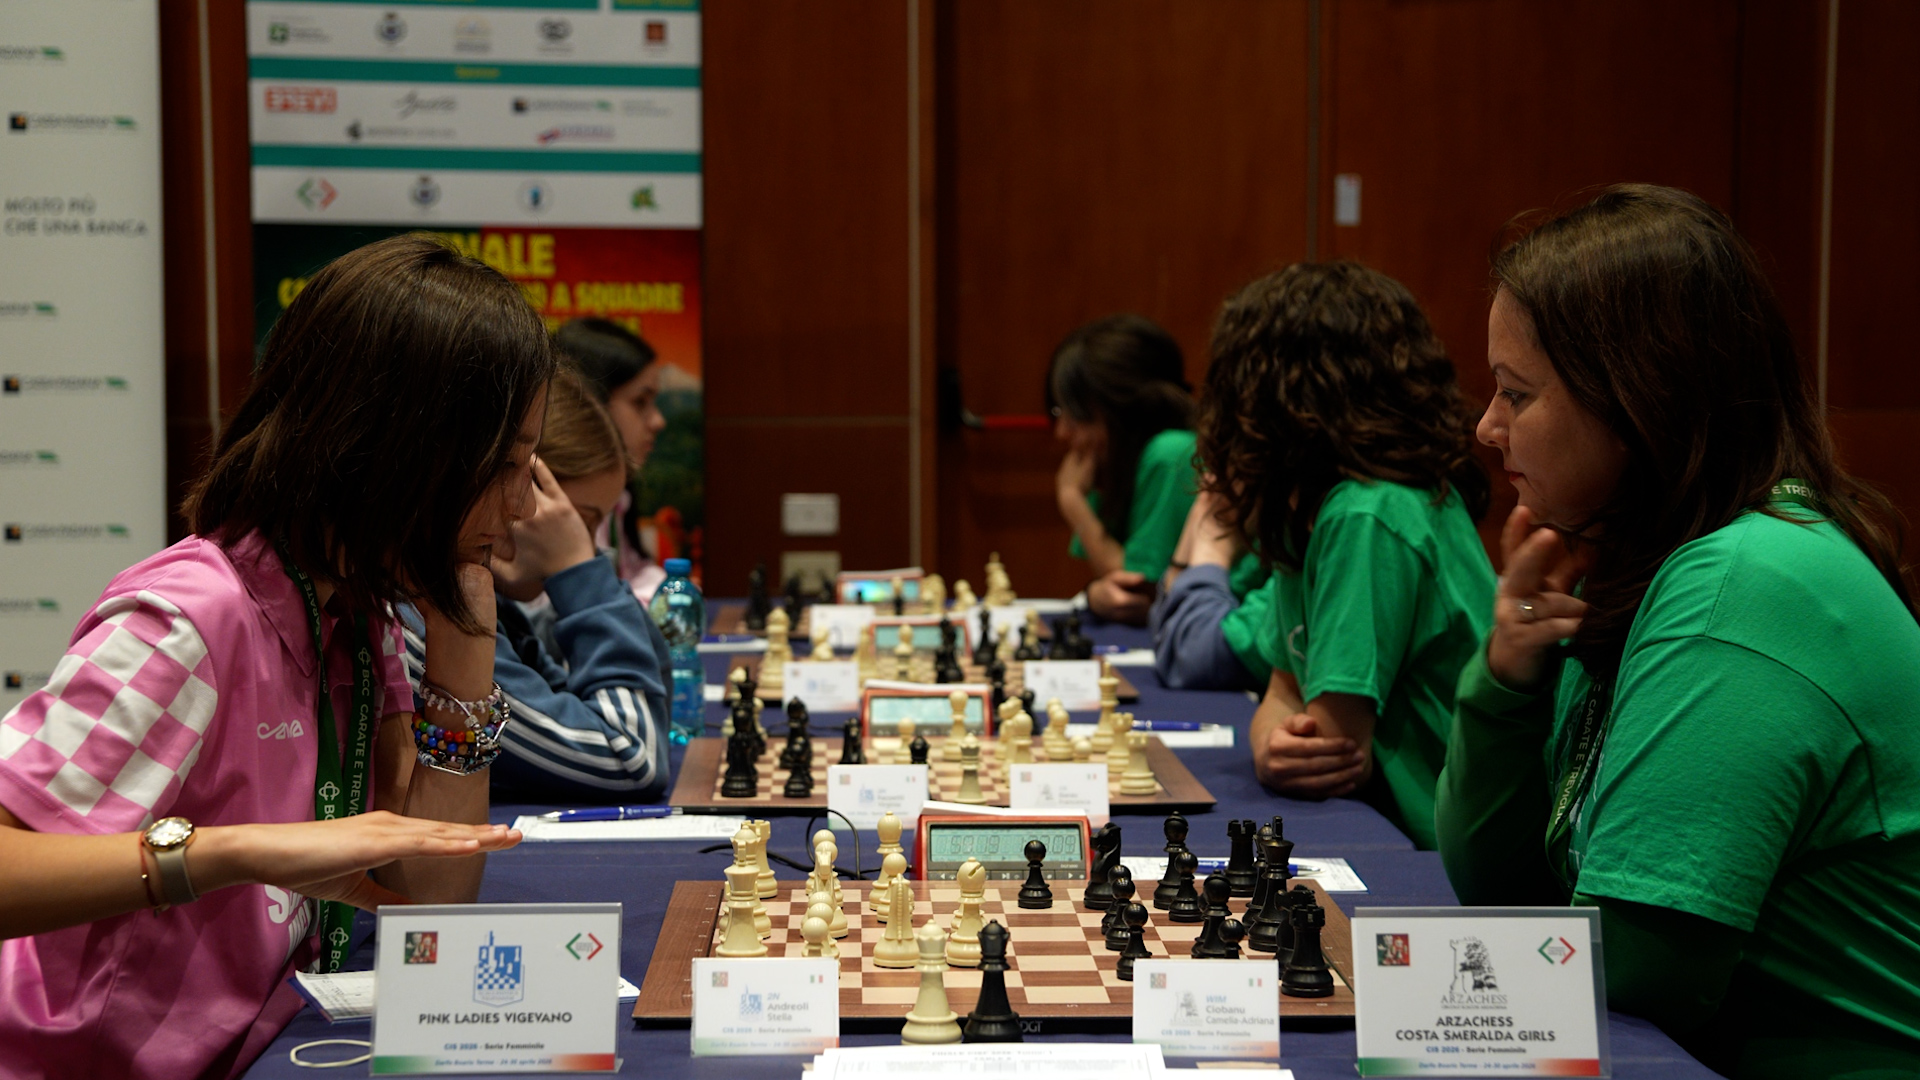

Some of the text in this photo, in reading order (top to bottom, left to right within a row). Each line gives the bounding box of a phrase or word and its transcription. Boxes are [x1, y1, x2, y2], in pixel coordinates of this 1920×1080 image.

[362, 670, 370, 696] BCC
[1579, 699, 1597, 750] CARATE
[354, 703, 369, 757] CARATE
[1575, 753, 1586, 762] E
[354, 760, 364, 769] E
[767, 1002, 809, 1011] Andreoli
[1206, 1006, 1246, 1014] Ciobanu
[419, 1012, 573, 1025] PINK LADIES VIGEVANO
[767, 1013, 792, 1021] Stella
[1206, 1016, 1275, 1025] Camelia-Adriana
[1436, 1016, 1513, 1027] ARZACHESS
[1396, 1030, 1556, 1041] COSTA SMERALDA GIRLS
[506, 1042, 545, 1050] Femminile
[1466, 1046, 1486, 1054] Serie
[1488, 1046, 1526, 1054] Femminile
